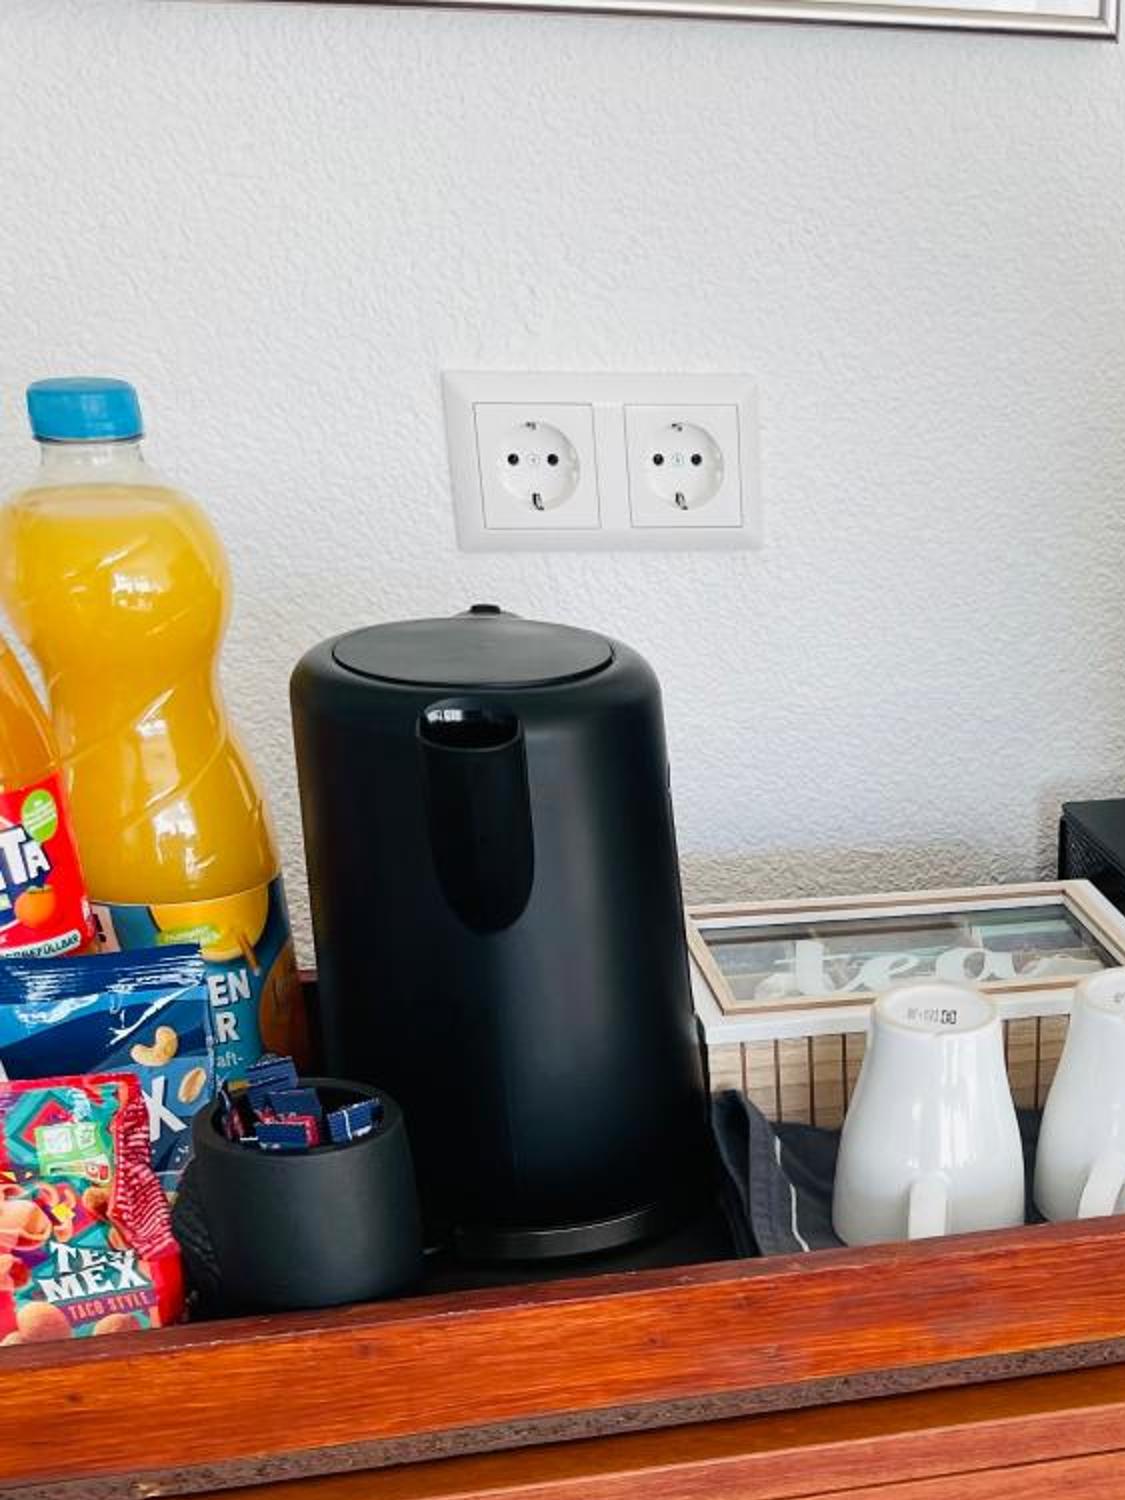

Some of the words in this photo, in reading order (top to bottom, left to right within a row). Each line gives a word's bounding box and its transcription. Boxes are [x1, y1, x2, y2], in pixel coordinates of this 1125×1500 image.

[0, 825, 52, 886] TA
[207, 968, 251, 1008] EN
[214, 1011, 241, 1044] R
[215, 1051, 244, 1068] aft-
[38, 1258, 153, 1303] MEX
[67, 1299, 105, 1321] TACO
[107, 1291, 151, 1311] STYLE
